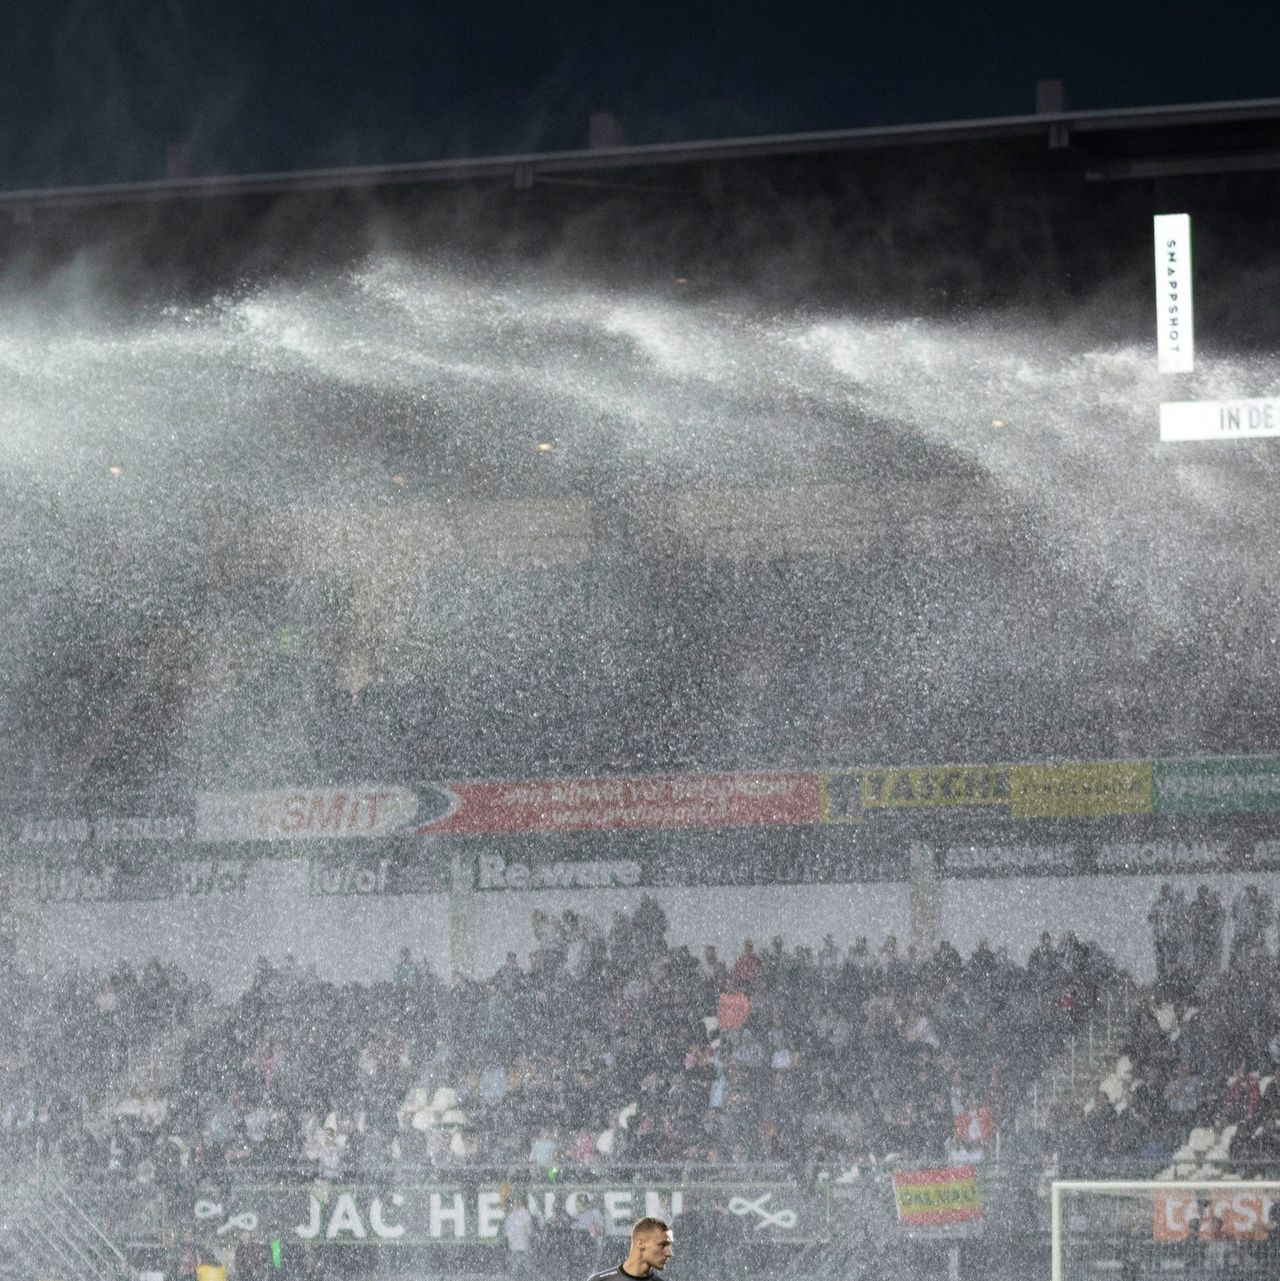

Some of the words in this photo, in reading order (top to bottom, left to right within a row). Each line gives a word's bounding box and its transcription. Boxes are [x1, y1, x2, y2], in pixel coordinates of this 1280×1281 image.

[1220, 407, 1242, 431] IN
[1248, 405, 1274, 430] DE
[294, 1192, 407, 1240] JAC
